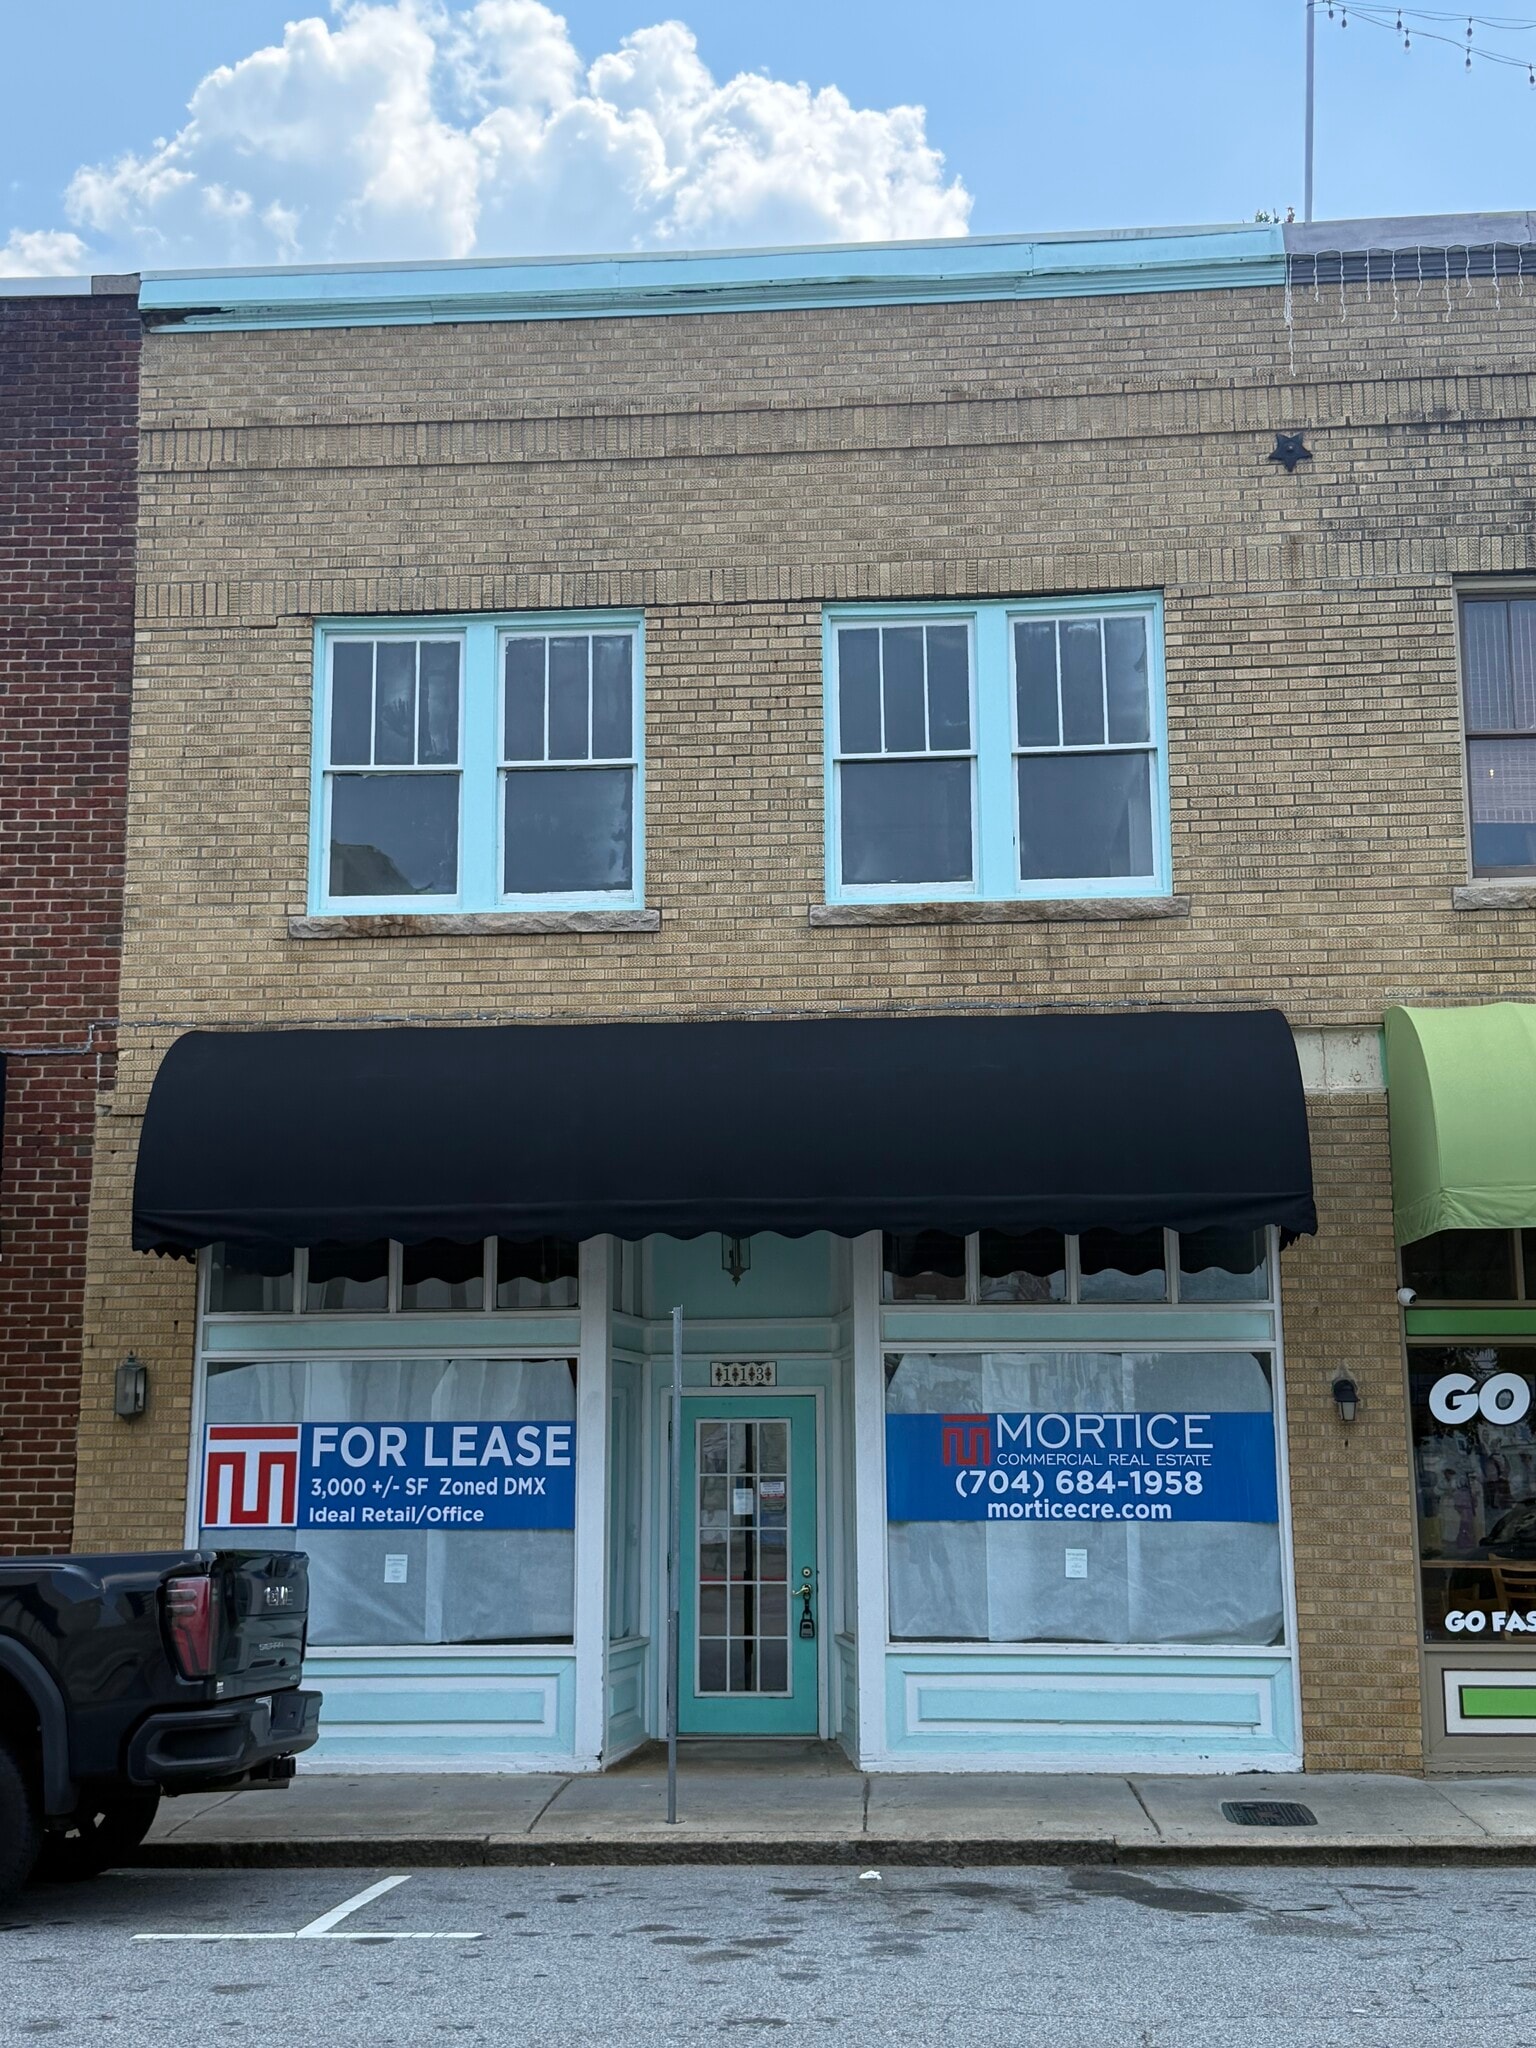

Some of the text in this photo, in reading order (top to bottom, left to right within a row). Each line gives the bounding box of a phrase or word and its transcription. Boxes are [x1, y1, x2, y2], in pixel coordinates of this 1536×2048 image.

[1428, 1372, 1531, 1425] GO
[996, 1413, 1214, 1450] MORTICE
[311, 1425, 572, 1467] FOR LEASE
[996, 1453, 1212, 1467] COMMERCIAL REAL ESTATE
[310, 1475, 547, 1499] 3,000 +/- SF Zoned DMX
[955, 1470, 1204, 1498] (704) 684-1958
[309, 1506, 485, 1524] Ideal Retail/Office
[987, 1499, 1172, 1520] morticecre.com
[1444, 1610, 1486, 1632] GO
